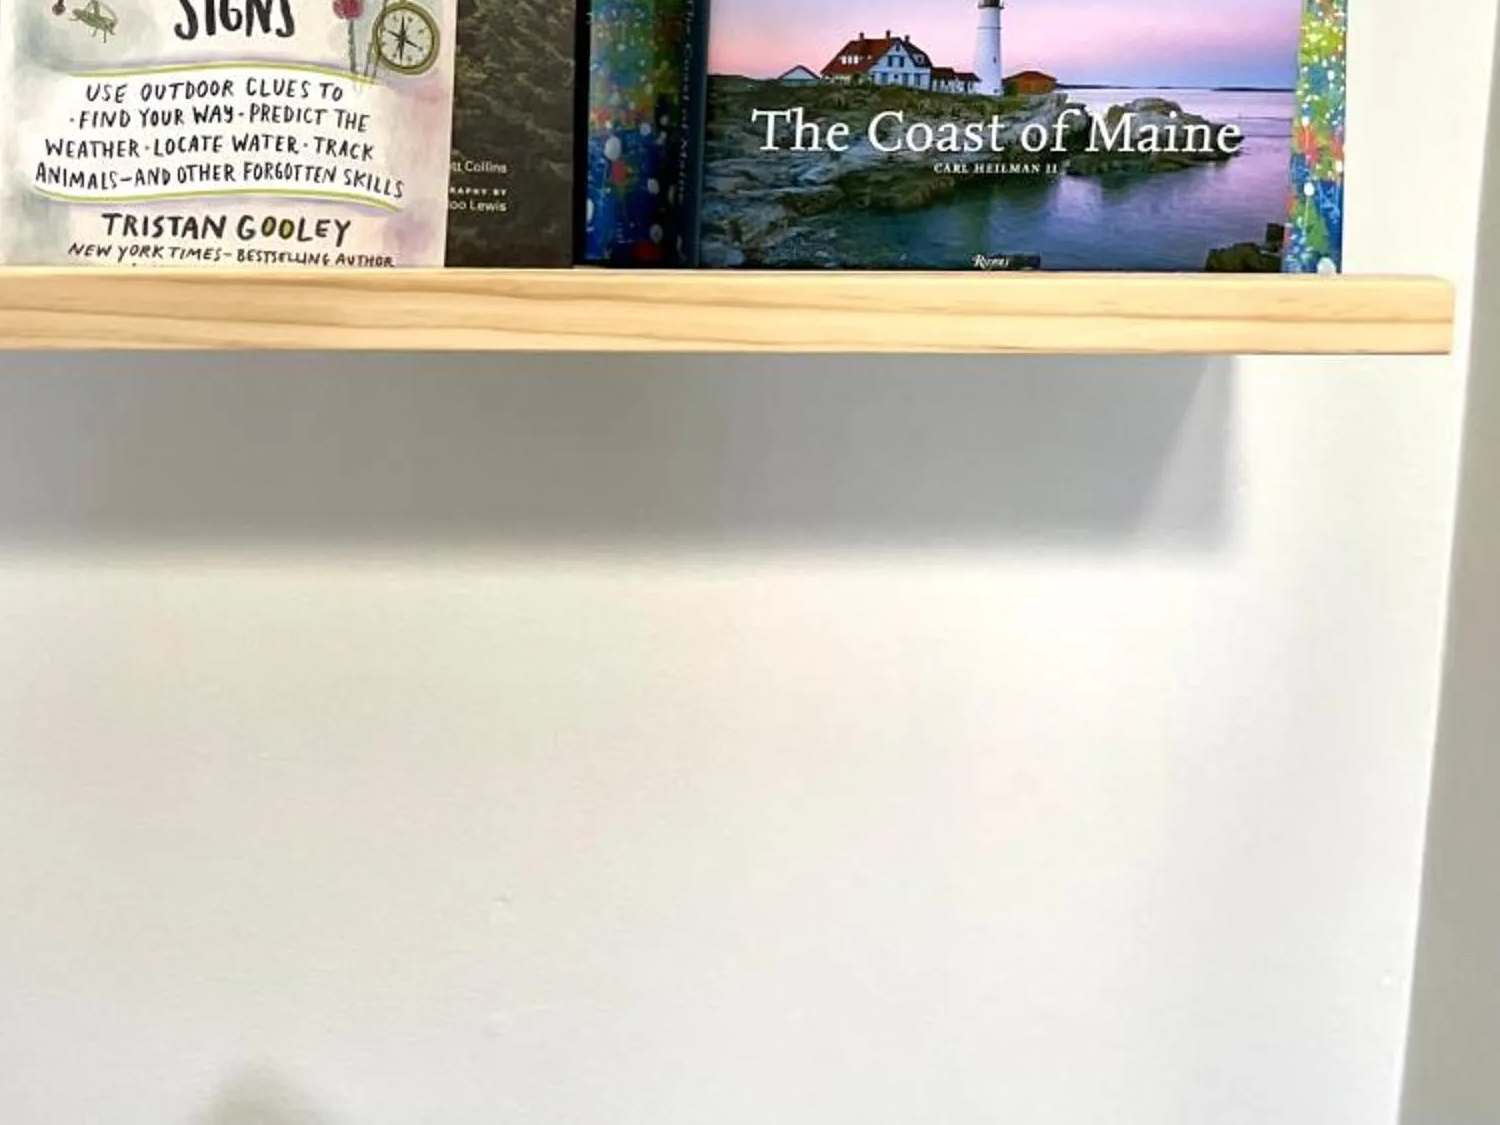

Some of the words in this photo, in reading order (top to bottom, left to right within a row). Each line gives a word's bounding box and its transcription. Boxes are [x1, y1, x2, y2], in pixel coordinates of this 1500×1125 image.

[85, 83, 128, 103] USE
[140, 80, 235, 101] OUTDOOR
[245, 78, 311, 98] CLUES
[319, 82, 344, 102] TO
[78, 109, 132, 130] FIND
[138, 108, 185, 127] YOUR
[192, 104, 234, 125] WAY
[249, 103, 329, 125] PREDICT
[334, 108, 370, 133] THE
[751, 106, 850, 153] The
[868, 109, 1004, 154] Coast
[1021, 108, 1081, 154] of
[1085, 110, 1243, 154] Maine
[44, 137, 141, 160] WEATHER
[153, 135, 224, 157] LOCATE
[231, 133, 299, 155] WATER
[313, 136, 374, 162] TRACK
[464, 160, 507, 173] Collins
[933, 162, 969, 174] CARL
[974, 162, 1040, 174] HEILMAN
[1045, 162, 1058, 174] II
[177, 162, 235, 184] OTHER
[243, 161, 337, 185] FORGOTTEN
[343, 166, 405, 200] SKILLS
[469, 199, 508, 212] Lewis
[100, 212, 228, 240] TRISTAN
[236, 214, 352, 248] GOOLEY
[68, 243, 112, 257] NEW
[118, 243, 164, 263] YORK
[236, 249, 330, 266] BESTSELLING
[335, 252, 396, 268] AUTHOR
